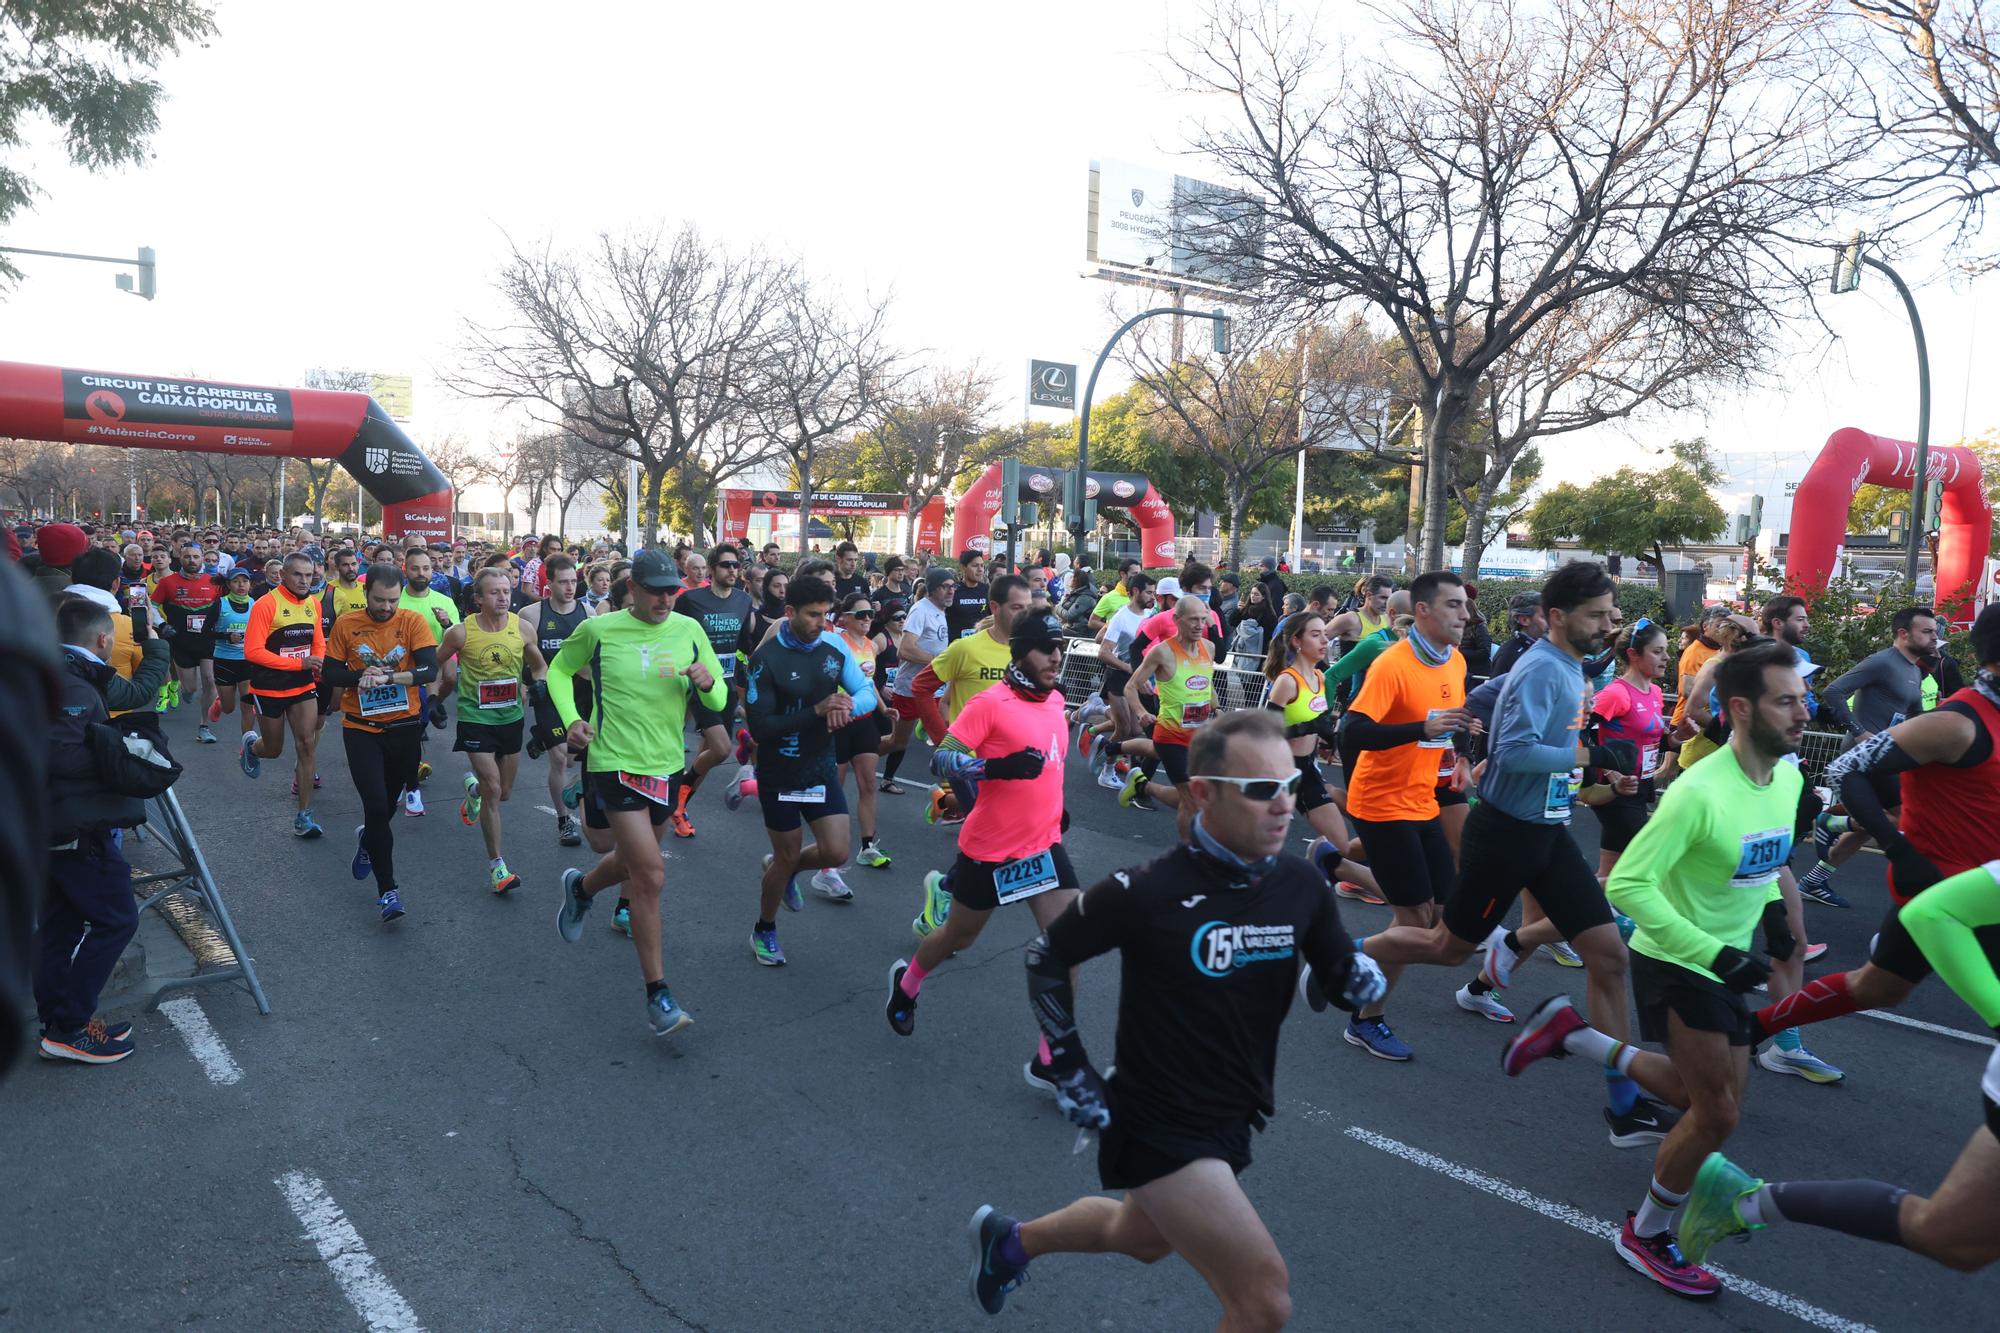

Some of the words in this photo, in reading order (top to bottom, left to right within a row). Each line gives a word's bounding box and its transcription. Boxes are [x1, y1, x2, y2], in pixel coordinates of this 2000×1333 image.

[81, 376, 152, 391] CIRCUIT
[156, 383, 181, 393] DE
[183, 385, 275, 401] CARRERES
[1034, 392, 1073, 403] LEXUS
[87, 425, 196, 441] #ValènciaCorre
[703, 613, 719, 621] XVI
[709, 618, 740, 626] PINEDO
[365, 686, 398, 703] 2253
[1749, 838, 1781, 866] 2131
[1002, 857, 1043, 885] 2229
